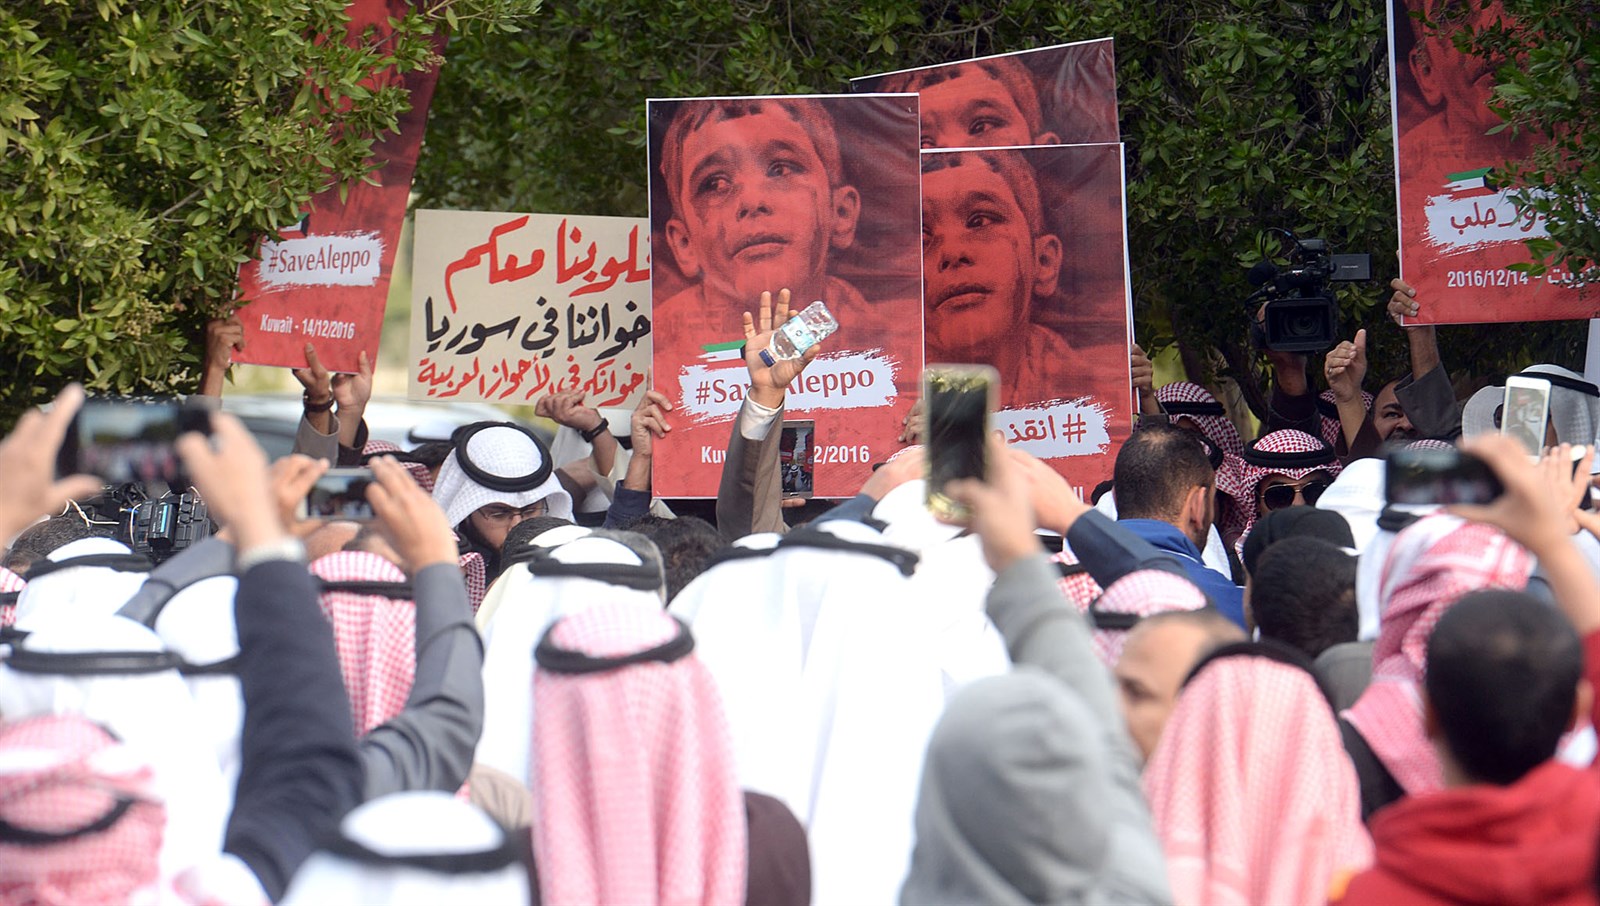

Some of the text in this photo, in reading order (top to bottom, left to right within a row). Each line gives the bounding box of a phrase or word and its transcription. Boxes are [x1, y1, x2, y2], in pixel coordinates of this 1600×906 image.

[268, 243, 371, 275] #SaveAleppo
[444, 215, 545, 313] معكم
[1447, 268, 1529, 288] 2016/12/14
[260, 314, 293, 334] Kuwait
[302, 318, 356, 339] 14/12/2016
[425, 296, 650, 361] خواننا في سوريا
[695, 368, 875, 406] #Saleppo
[813, 445, 870, 464] 2/2016
